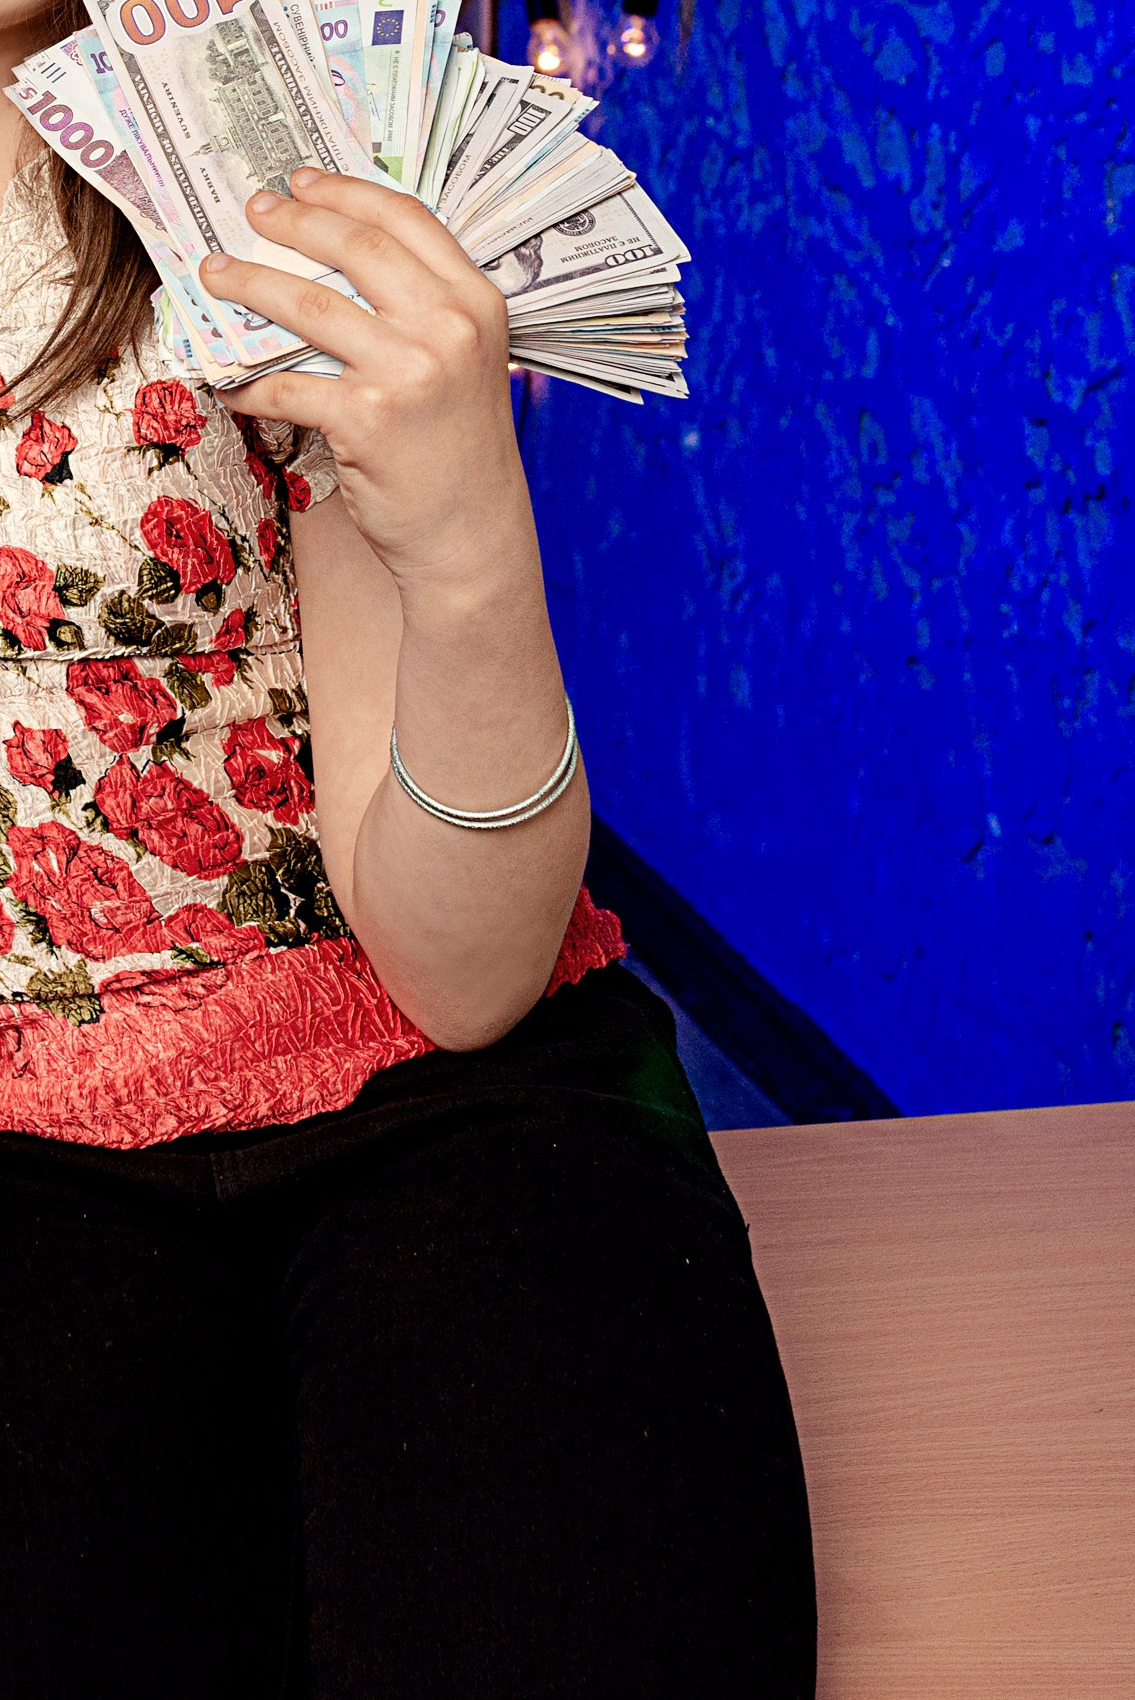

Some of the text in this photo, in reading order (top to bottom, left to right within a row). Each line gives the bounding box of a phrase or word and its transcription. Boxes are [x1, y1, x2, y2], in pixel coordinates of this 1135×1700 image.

[27, 90, 115, 168] 1000
[159, 80, 222, 204] BABKY SUVENIRY
[604, 244, 654, 267] 100
